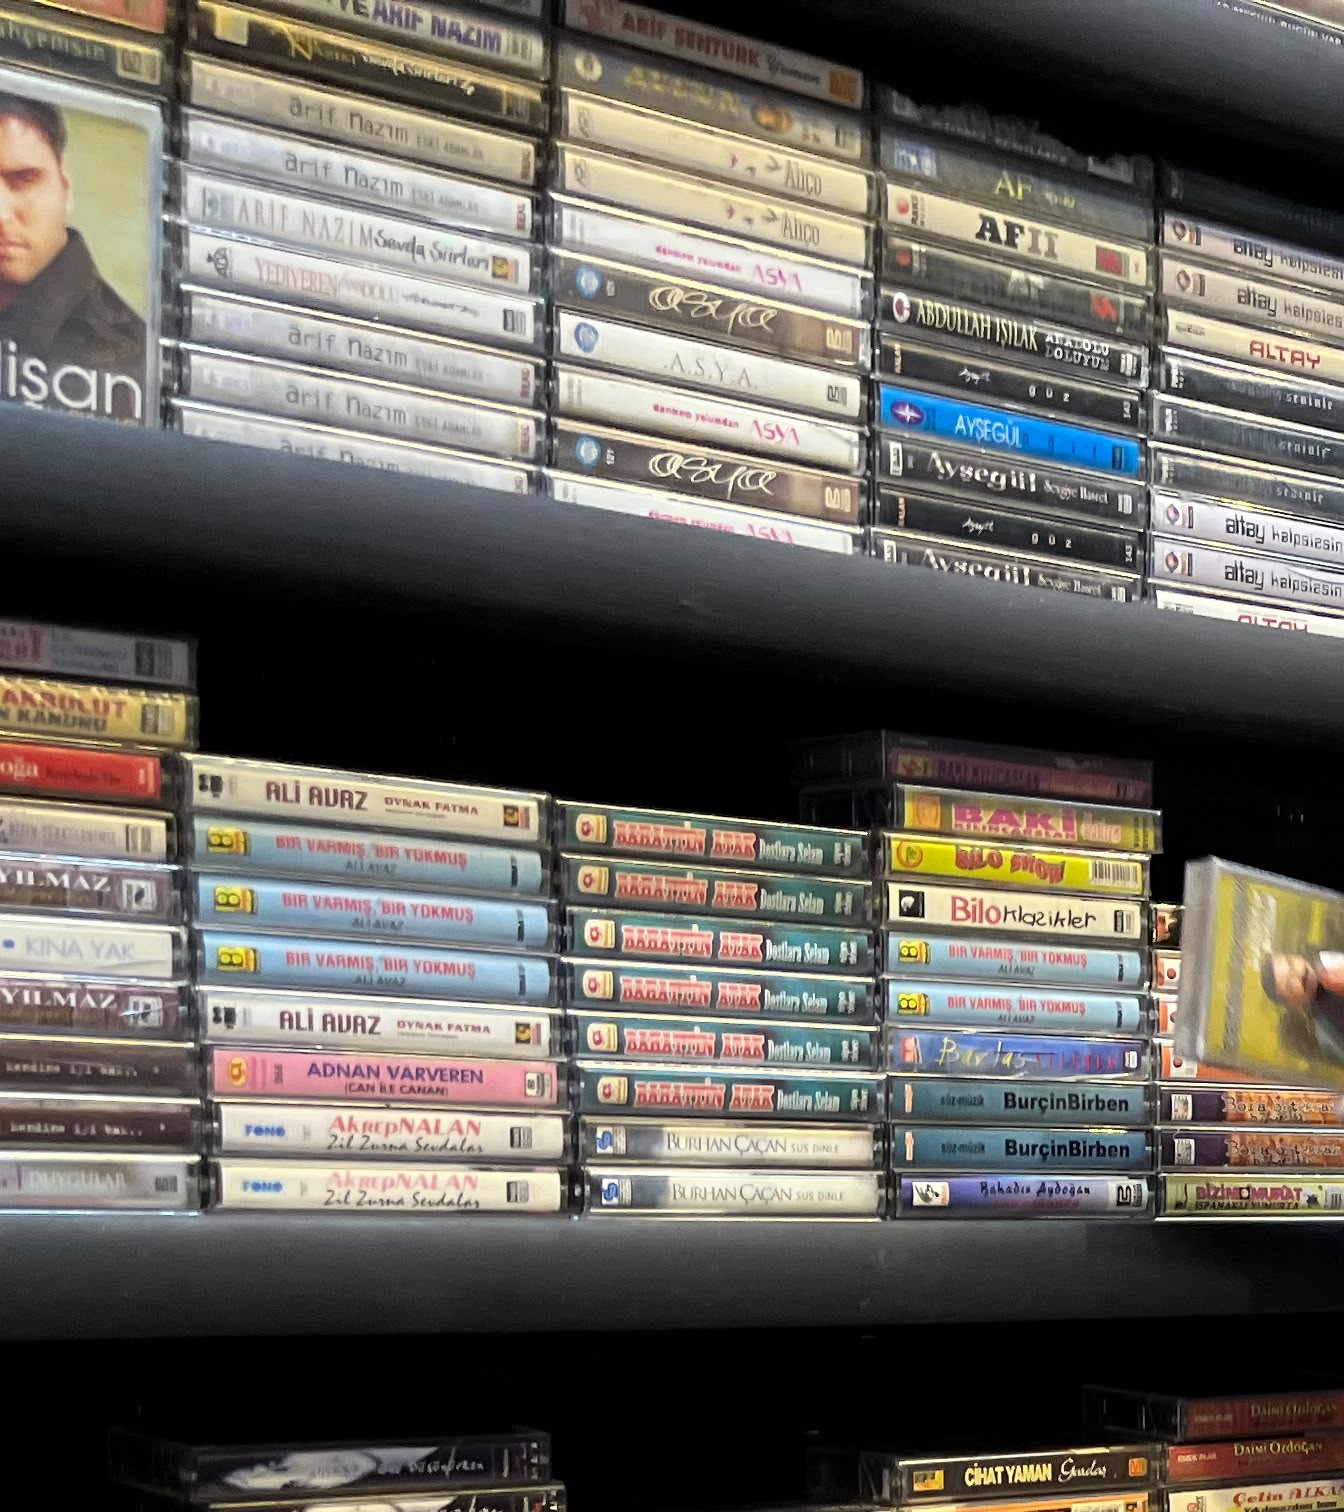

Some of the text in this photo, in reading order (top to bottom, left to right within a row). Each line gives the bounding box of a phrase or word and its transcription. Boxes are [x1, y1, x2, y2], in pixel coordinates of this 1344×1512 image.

[1249, 339, 1321, 370] ALTAY
[0, 336, 143, 420] işan
[954, 419, 1024, 450] AYŞEGÜL
[24, 937, 135, 962] KINA YAK
[307, 1061, 484, 1084] ADNAN VARVEREN
[1003, 1090, 1130, 1116] BurçinBirben
[1003, 1138, 1131, 1162] BurçinBirben
[964, 1462, 1003, 1486] CİHAT
[1004, 1463, 1052, 1484] YAMAN
